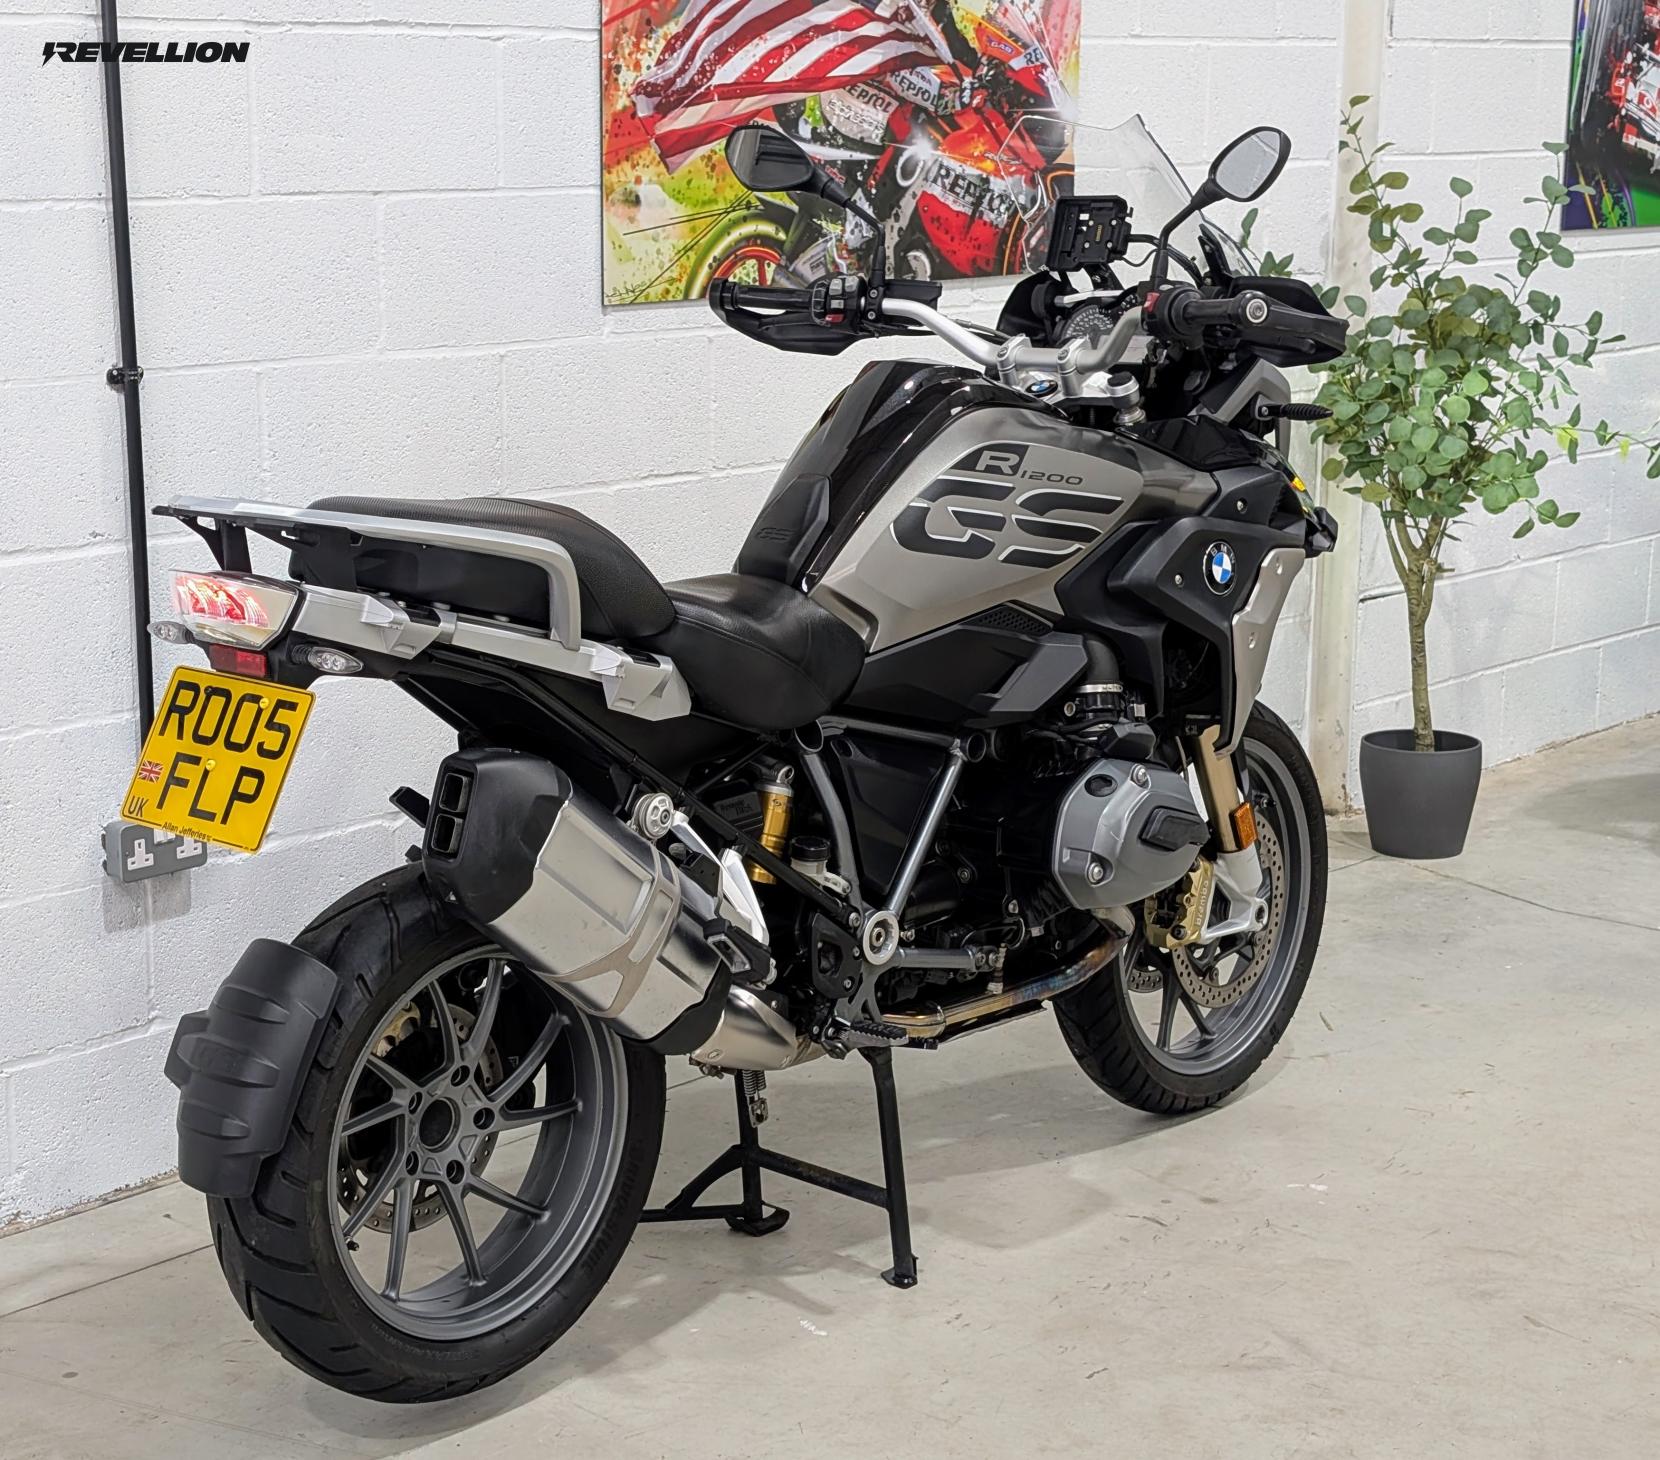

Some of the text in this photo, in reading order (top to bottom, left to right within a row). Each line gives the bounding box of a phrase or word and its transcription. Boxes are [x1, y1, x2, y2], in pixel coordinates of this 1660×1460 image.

[843, 84, 893, 113] EPSOL
[975, 450, 1084, 486] R 1200
[889, 475, 1125, 569] GS
[156, 752, 266, 826] FLP
[127, 796, 150, 818] UK
[162, 821, 179, 833] Allan
